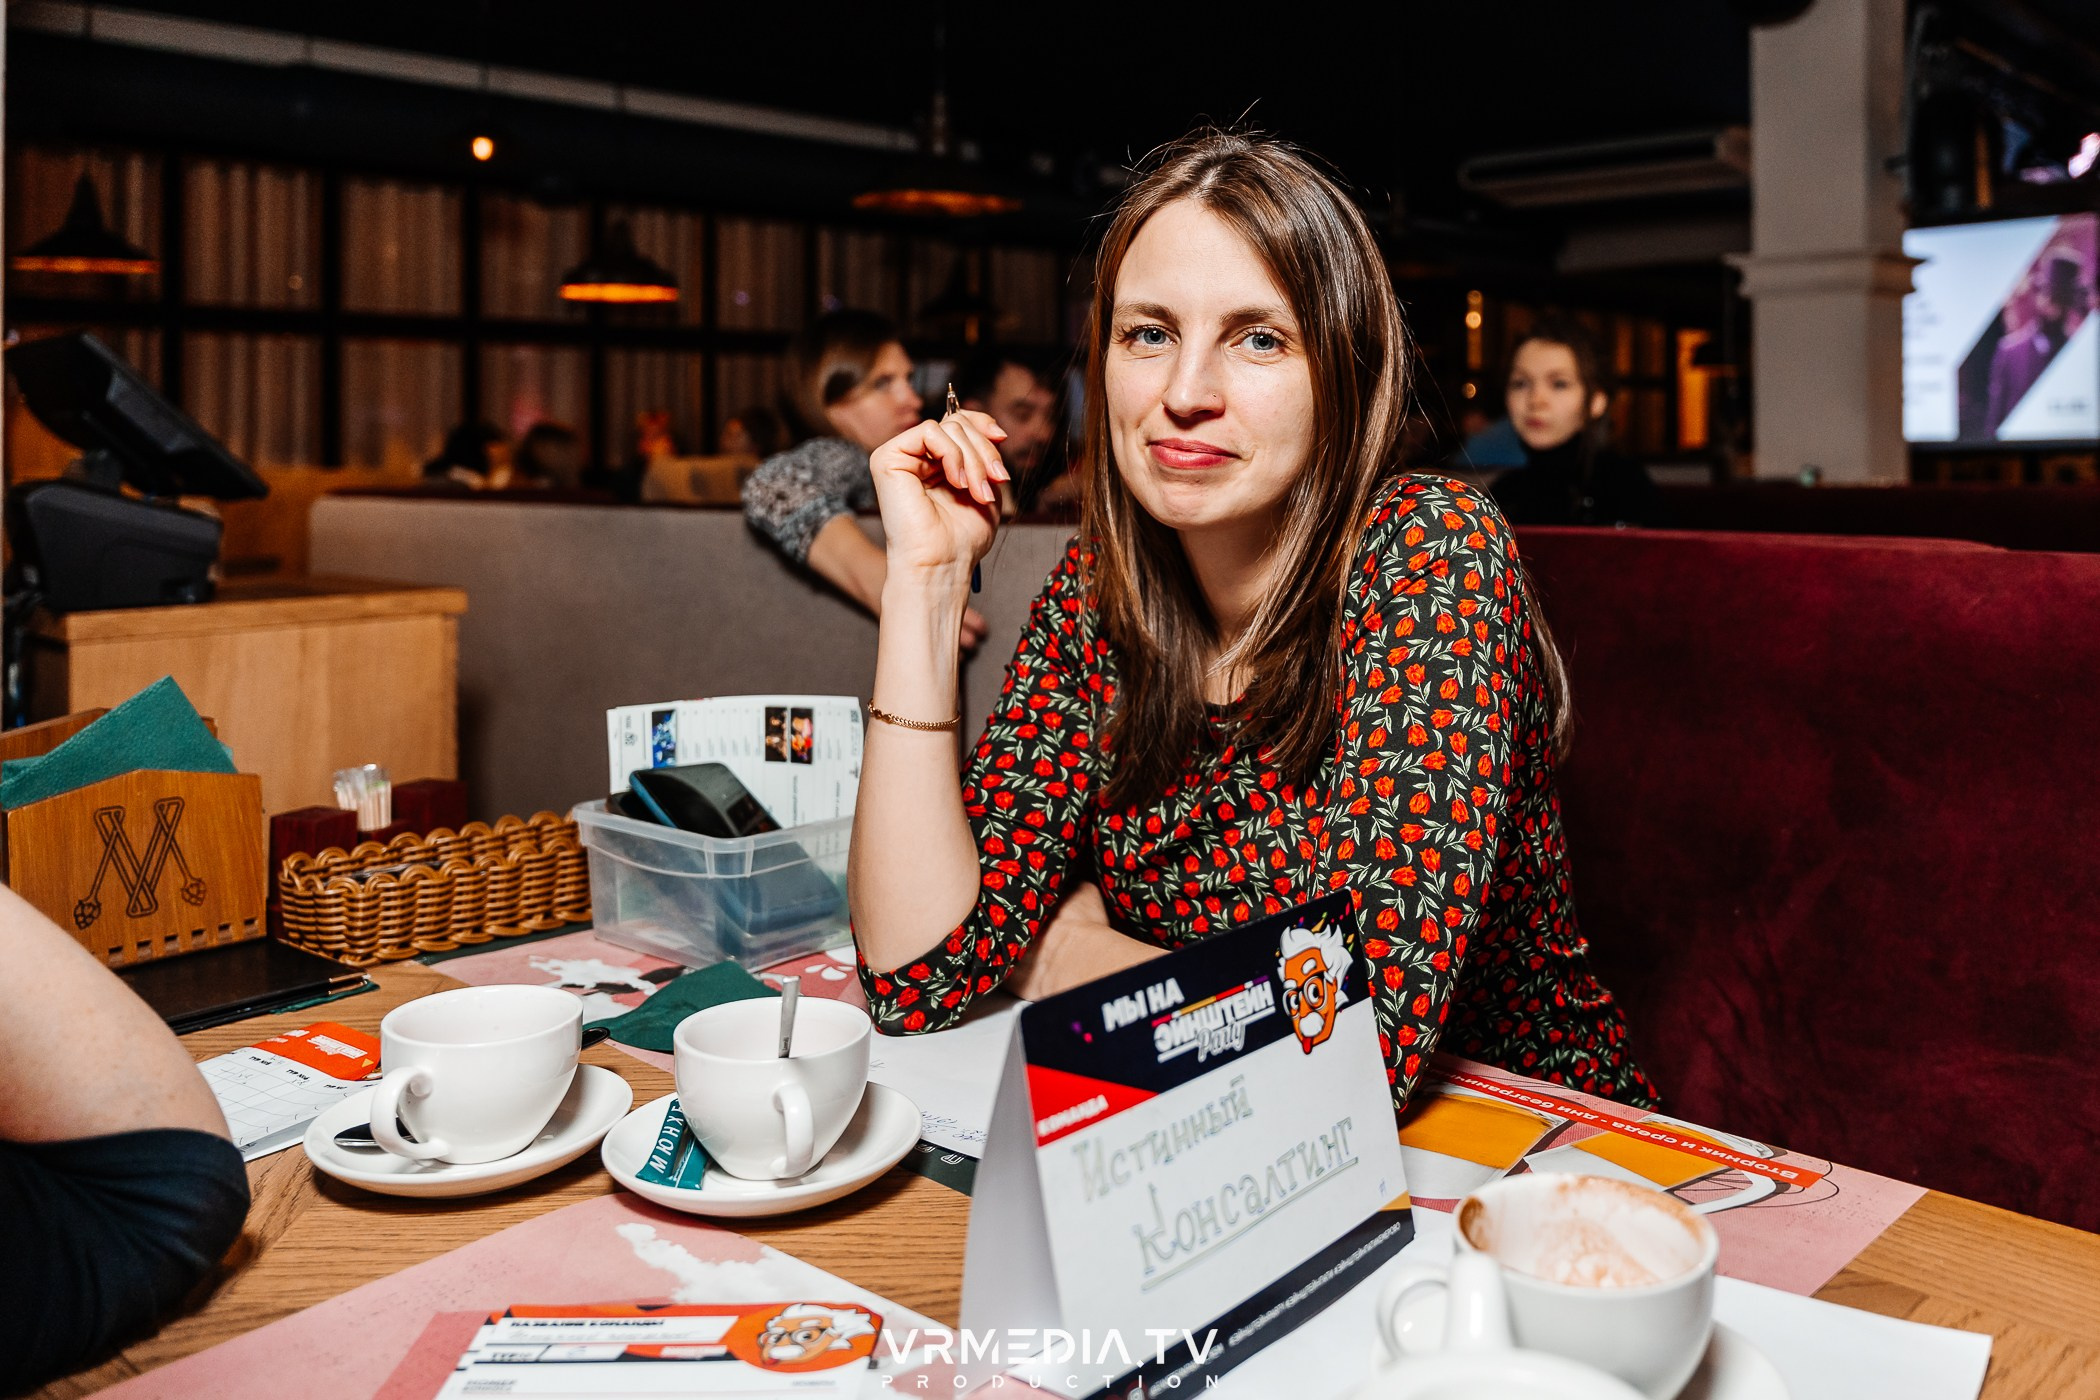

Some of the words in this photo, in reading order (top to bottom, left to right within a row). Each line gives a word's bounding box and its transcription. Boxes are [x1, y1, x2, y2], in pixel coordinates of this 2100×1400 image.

[1101, 989, 1148, 1033] МЫ
[1146, 977, 1185, 1014] НА
[1153, 980, 1275, 1052] ЭЙНШТЕЙН
[1197, 1021, 1247, 1062] Party
[1557, 1104, 1599, 1121] дни
[649, 1100, 684, 1174] МЮНХЕ
[1612, 1121, 1678, 1145] среда
[1681, 1140, 1698, 1150] и
[1698, 1145, 1800, 1180] Вторник
